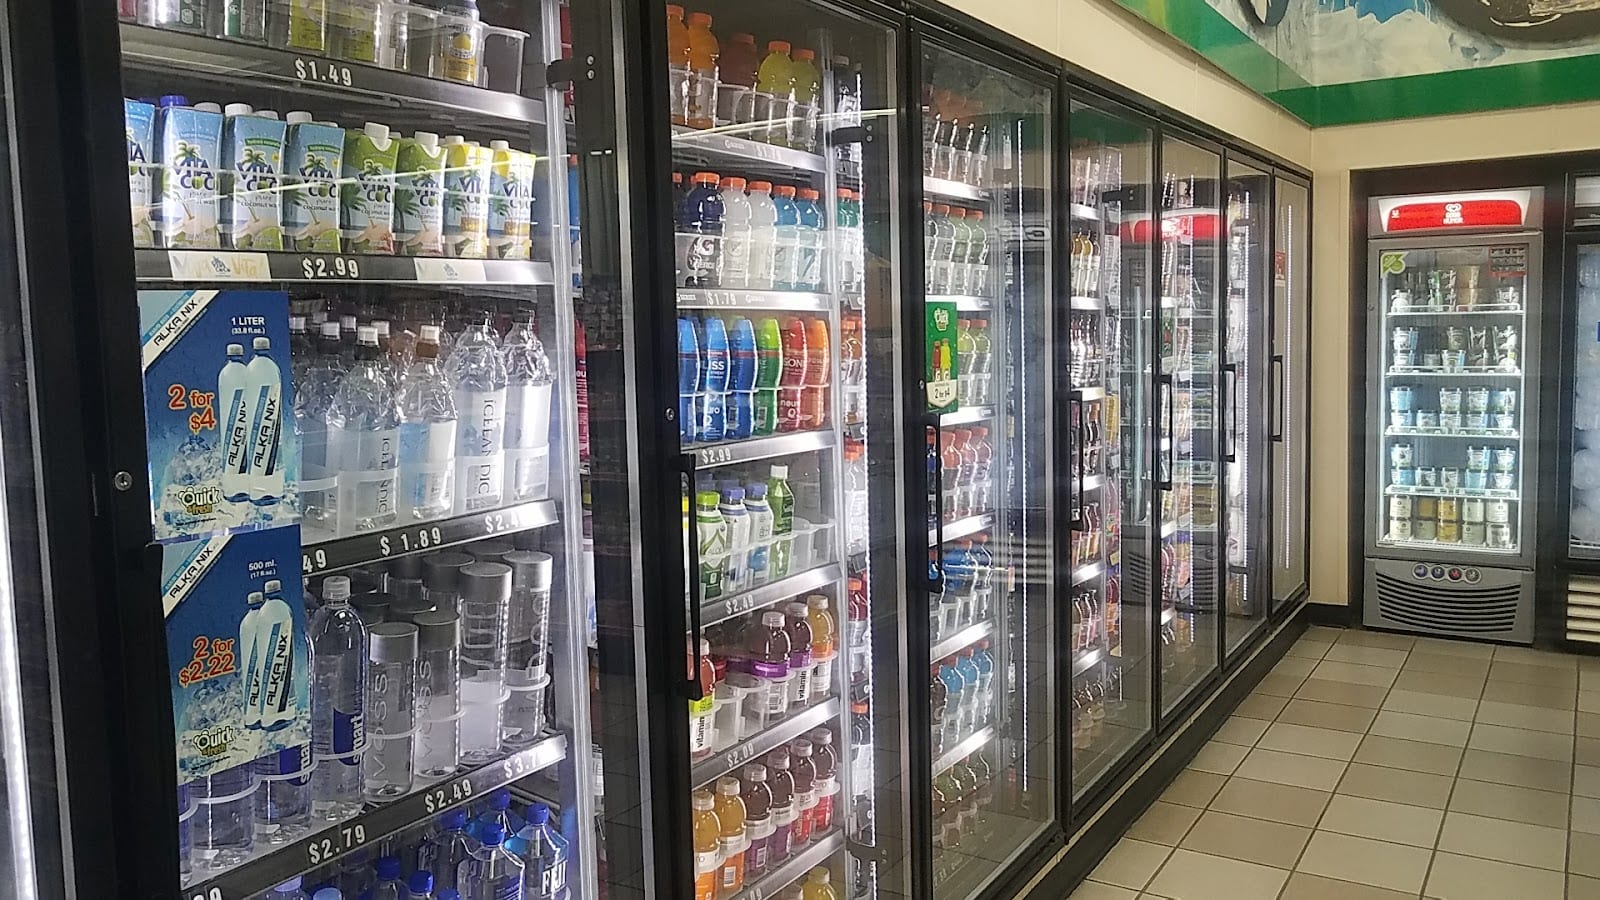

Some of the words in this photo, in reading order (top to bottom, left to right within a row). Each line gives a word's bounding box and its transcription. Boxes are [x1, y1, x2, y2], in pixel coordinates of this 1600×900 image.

[294, 57, 353, 87] $1.49
[236, 162, 278, 182] VITA
[302, 257, 359, 279] $2.99
[153, 316, 183, 346] ALKA
[180, 299, 198, 318] NIX
[231, 317, 236, 325] 1
[238, 317, 265, 325] LITER
[168, 384, 186, 409] 2
[190, 390, 214, 407] for
[190, 407, 216, 433] $4
[254, 425, 271, 467] ALKA
[264, 398, 276, 421] NIX
[228, 426, 244, 466] ALKA
[702, 448, 732, 465] $2.99
[178, 486, 219, 506] Quick
[169, 565, 198, 598] ALKA
[195, 547, 213, 566] NIX
[248, 560, 263, 571] 500
[193, 636, 209, 659] 2
[212, 638, 235, 656] for
[178, 652, 237, 688] $2.22
[266, 662, 281, 706] ALKA
[276, 634, 288, 659] NIX
[798, 670, 807, 699] vitamin
[193, 725, 234, 750] Quick
[697, 716, 705, 748] vitamin
[308, 825, 366, 865] $2.79
[424, 779, 472, 814] $2.49
